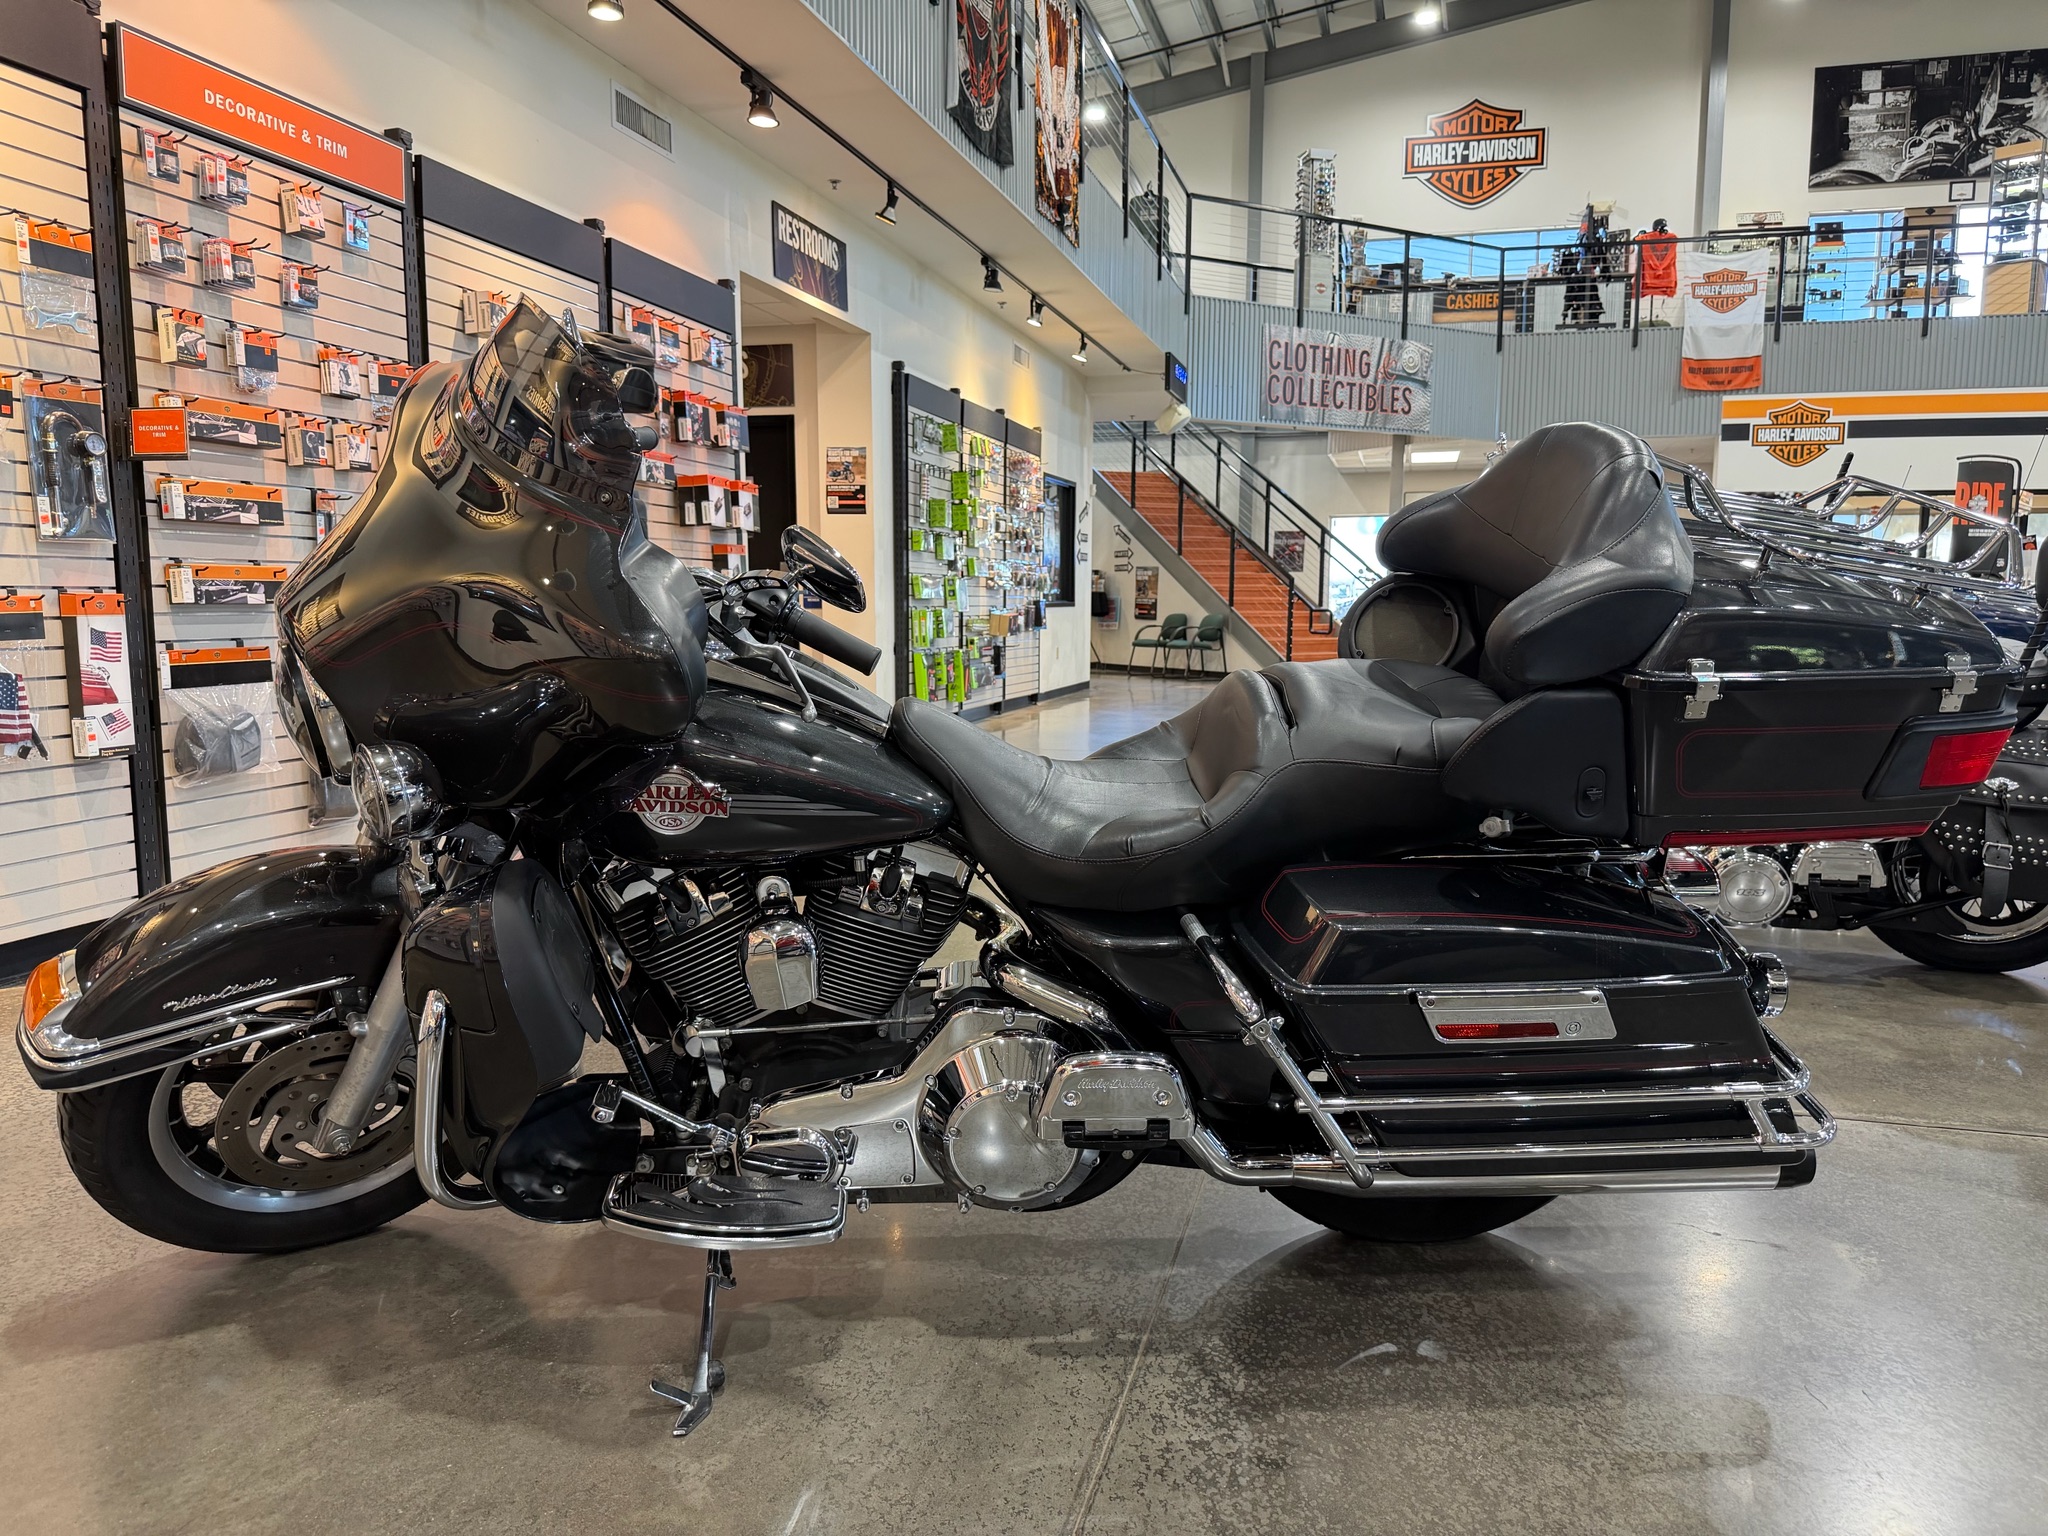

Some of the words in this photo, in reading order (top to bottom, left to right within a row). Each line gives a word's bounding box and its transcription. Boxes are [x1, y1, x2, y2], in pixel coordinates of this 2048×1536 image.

[203, 87, 297, 138] DECORATIVE
[301, 128, 312, 145] &
[315, 134, 348, 159] TRIM
[1442, 112, 1510, 136] MOTOR
[1413, 136, 1537, 167] HARLEY-DAVIDSON
[1440, 168, 1506, 197] CYCLES
[777, 208, 839, 271] RESTROOMS
[1710, 273, 1741, 283] MOTOR
[1695, 282, 1754, 296] HARLEY-DAVIDSON
[1707, 297, 1740, 310] CYCLES
[1268, 339, 1371, 379] CLOTHING
[1267, 374, 1413, 415] COLLECTIBLES
[1778, 411, 1820, 424] MOTOR
[1757, 426, 1840, 443] HARLEY-DAVIDSON
[1776, 445, 1820, 462] CYCLES
[1952, 481, 2008, 526] RIDE
[640, 785, 724, 800] ARLEY-
[629, 799, 728, 816] AVIDSON
[661, 818, 681, 827] USA
